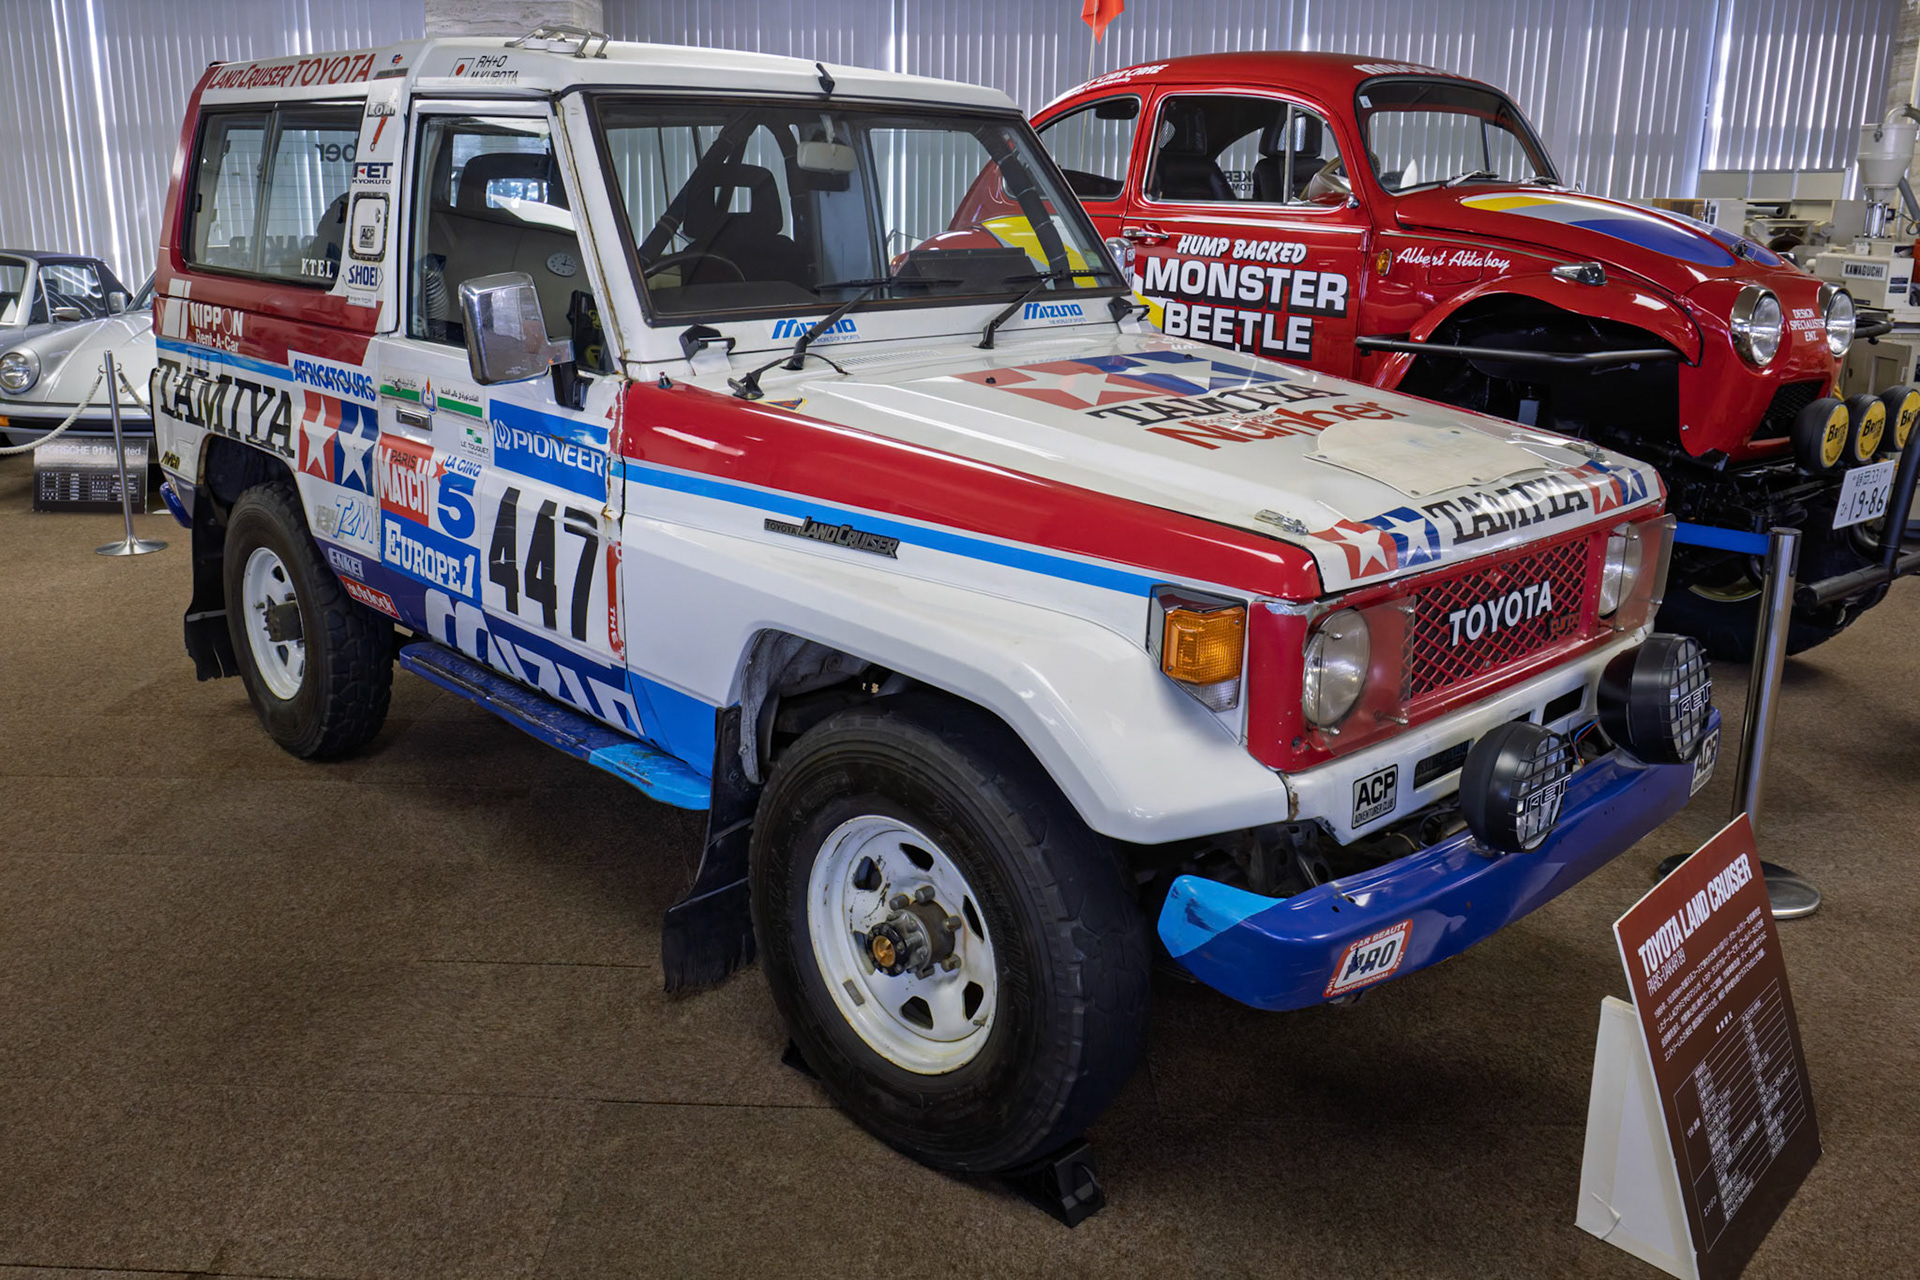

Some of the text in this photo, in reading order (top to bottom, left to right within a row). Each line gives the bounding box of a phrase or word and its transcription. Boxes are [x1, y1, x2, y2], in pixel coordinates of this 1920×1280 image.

[290, 53, 377, 87] TOYOTA
[353, 162, 393, 178] FET
[1177, 235, 1307, 264] HUMP BACKED
[1396, 246, 1510, 274] Albert Attaboy
[301, 258, 334, 279] KTEL
[348, 264, 378, 287] SHOEI
[1145, 256, 1348, 311] MONSTER
[1845, 264, 1884, 278] KAWAGUCHI
[189, 302, 244, 337] NIPPON
[1024, 302, 1083, 320] MIZUNO
[1165, 301, 1312, 354] BEETLE
[1789, 319, 1825, 331] SPECIALISTS
[1792, 308, 1815, 319] DESIGN
[1804, 330, 1819, 342] ENT.
[293, 359, 377, 402] AFRICATOURS
[157, 357, 296, 459] TAMIYA
[1085, 384, 1349, 427] TAMIYA
[109, 446, 141, 456] Lited
[390, 449, 416, 470] PARIS
[467, 441, 489, 454] TOUQUET
[512, 429, 604, 477] PIONEER
[379, 445, 429, 516] MATCH
[445, 455, 482, 477] LA CINQ
[333, 495, 374, 544] T2M
[437, 471, 477, 539] 5
[1421, 475, 1589, 546] TAMIYA
[1848, 485, 1888, 521] 19-86
[765, 520, 798, 537] TOYOTA
[328, 547, 365, 578] ENKEI
[384, 518, 462, 593] EUROPE
[462, 554, 475, 599] 1
[488, 486, 599, 642] 447
[1450, 580, 1552, 647] TOYOTA
[1694, 731, 1719, 779] ACP
[1355, 771, 1396, 812] ACP
[1524, 774, 1571, 815] FET
[1637, 915, 1685, 978] TOYOTA
[1678, 889, 1711, 940] LAND
[1707, 853, 1753, 912] CRUISER
[1350, 922, 1409, 951] CAR BEAUTY
[1325, 976, 1337, 994] THE
